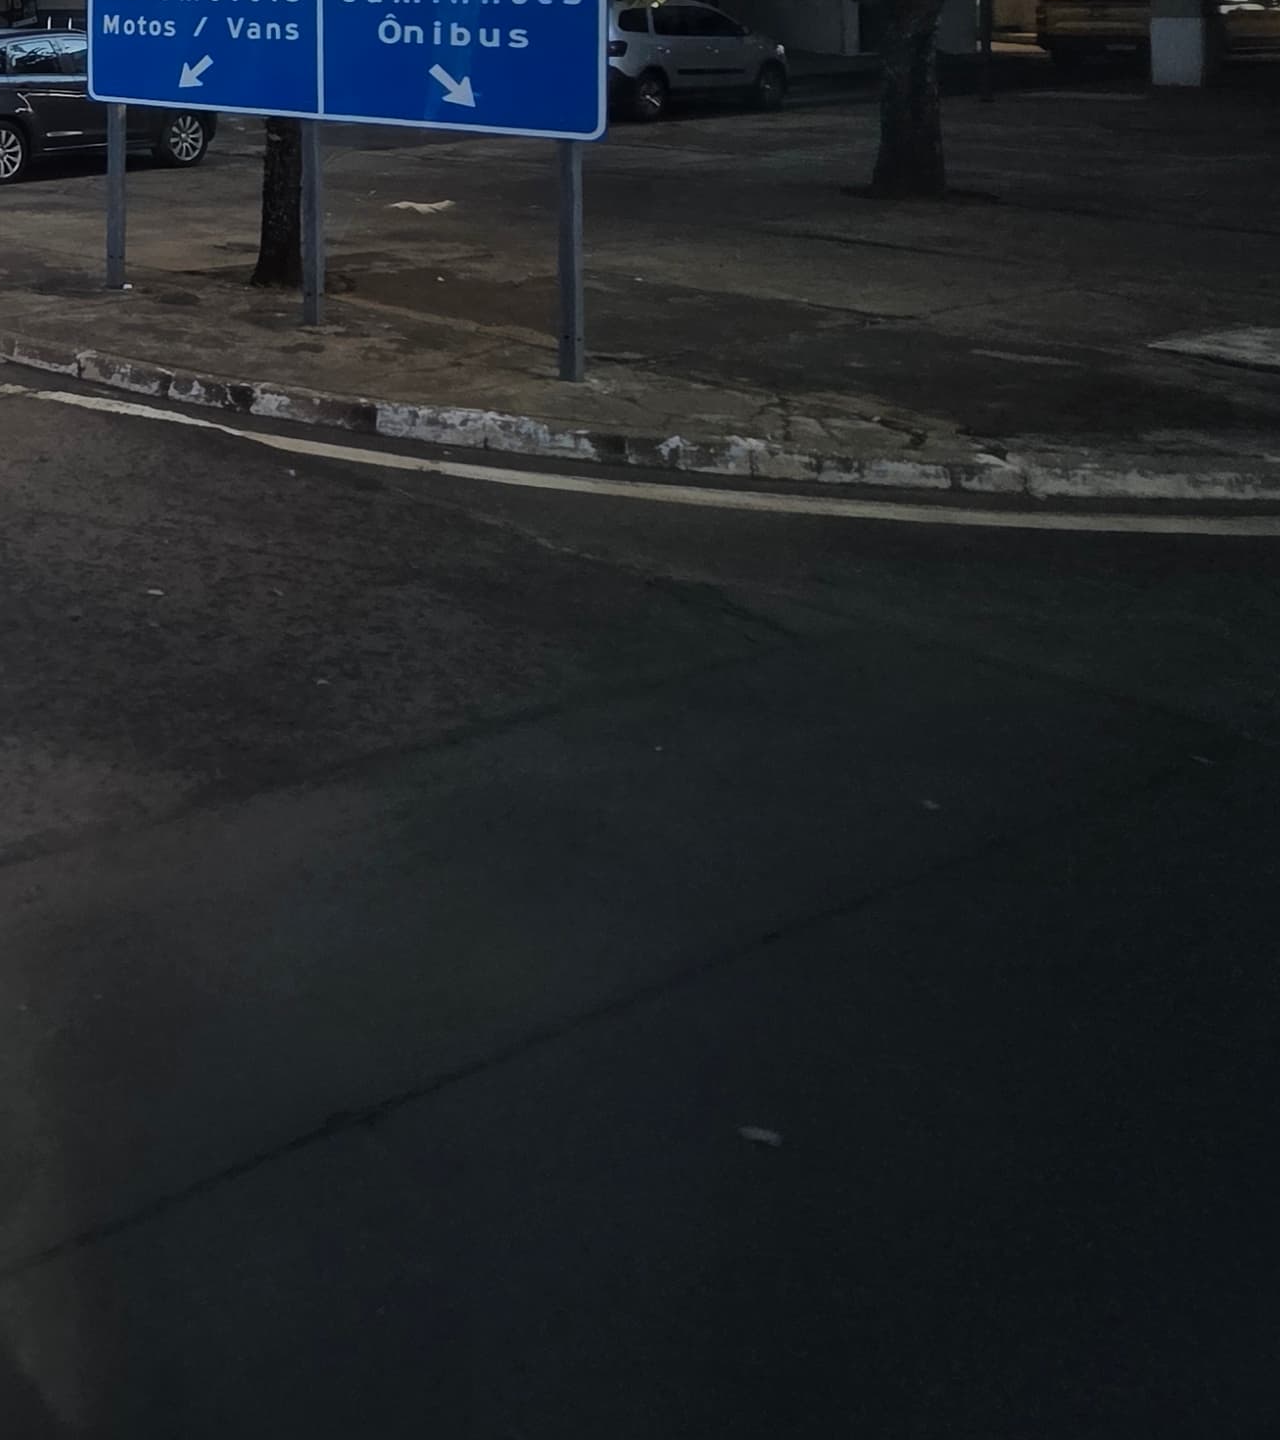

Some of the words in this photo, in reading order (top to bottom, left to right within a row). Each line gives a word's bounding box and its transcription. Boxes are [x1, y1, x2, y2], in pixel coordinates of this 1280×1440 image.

[102, 15, 177, 38] Motos
[193, 16, 208, 38] /
[227, 17, 300, 40] Vans
[378, 13, 529, 48] Ônibus
